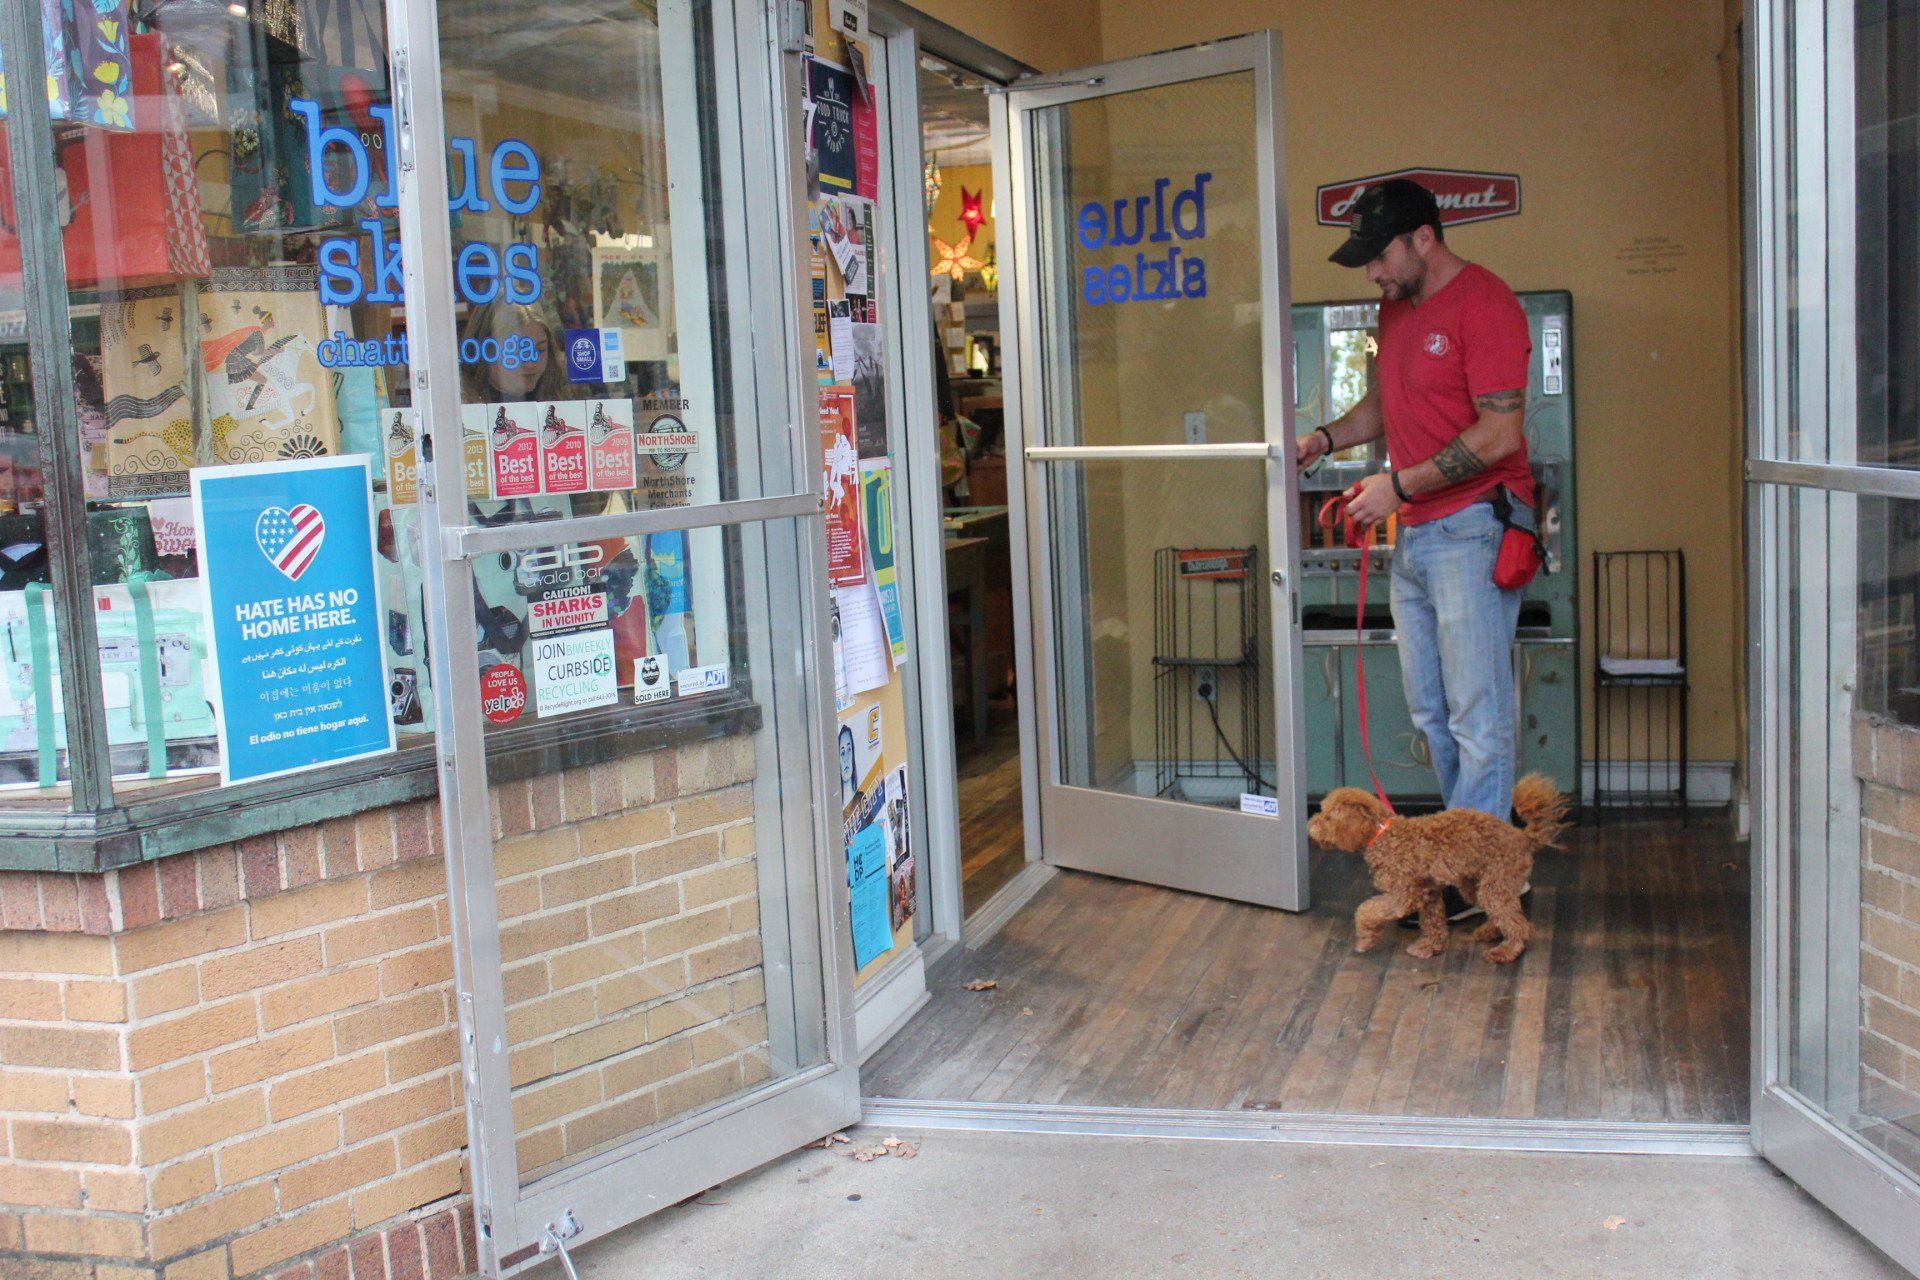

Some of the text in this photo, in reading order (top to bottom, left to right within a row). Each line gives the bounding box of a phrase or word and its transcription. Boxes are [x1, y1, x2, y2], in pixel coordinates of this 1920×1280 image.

[318, 218, 542, 305] skes
[316, 331, 538, 370] chattooga
[643, 399, 690, 411] MEMBER
[467, 445, 483, 454] 2013
[517, 442, 533, 451] 2012
[565, 440, 582, 449] 2010
[612, 438, 629, 447] 2009
[498, 454, 535, 474] Best
[547, 452, 583, 472] Best
[595, 450, 630, 469] Best
[500, 474, 535, 484] of the best
[549, 471, 583, 481] of the best
[596, 468, 630, 478] of the best
[643, 475, 696, 487] NorthShore
[648, 489, 693, 499] Merchants
[543, 585, 592, 600] CAUTION!
[235, 588, 359, 621] HATE HAS NO
[533, 595, 603, 617] SHARKS
[242, 608, 357, 640] HOME HERE.
[542, 612, 595, 628] IN VICINITY
[537, 638, 611, 660] JOIN BIWEEKLY
[491, 670, 514, 679] PEOPLE
[548, 656, 610, 681] CURBSIDE
[488, 679, 507, 688] LOVE
[705, 670, 725, 687] ADT
[539, 679, 599, 701] RECYCLING
[635, 693, 653, 703] SOLD
[653, 690, 670, 700] HERE
[485, 695, 513, 714] yelp
[588, 695, 596, 703] call
[249, 734, 259, 745] El
[260, 731, 281, 744] odio
[283, 730, 295, 739] no
[296, 725, 319, 736] tiene
[320, 719, 347, 732] hogar
